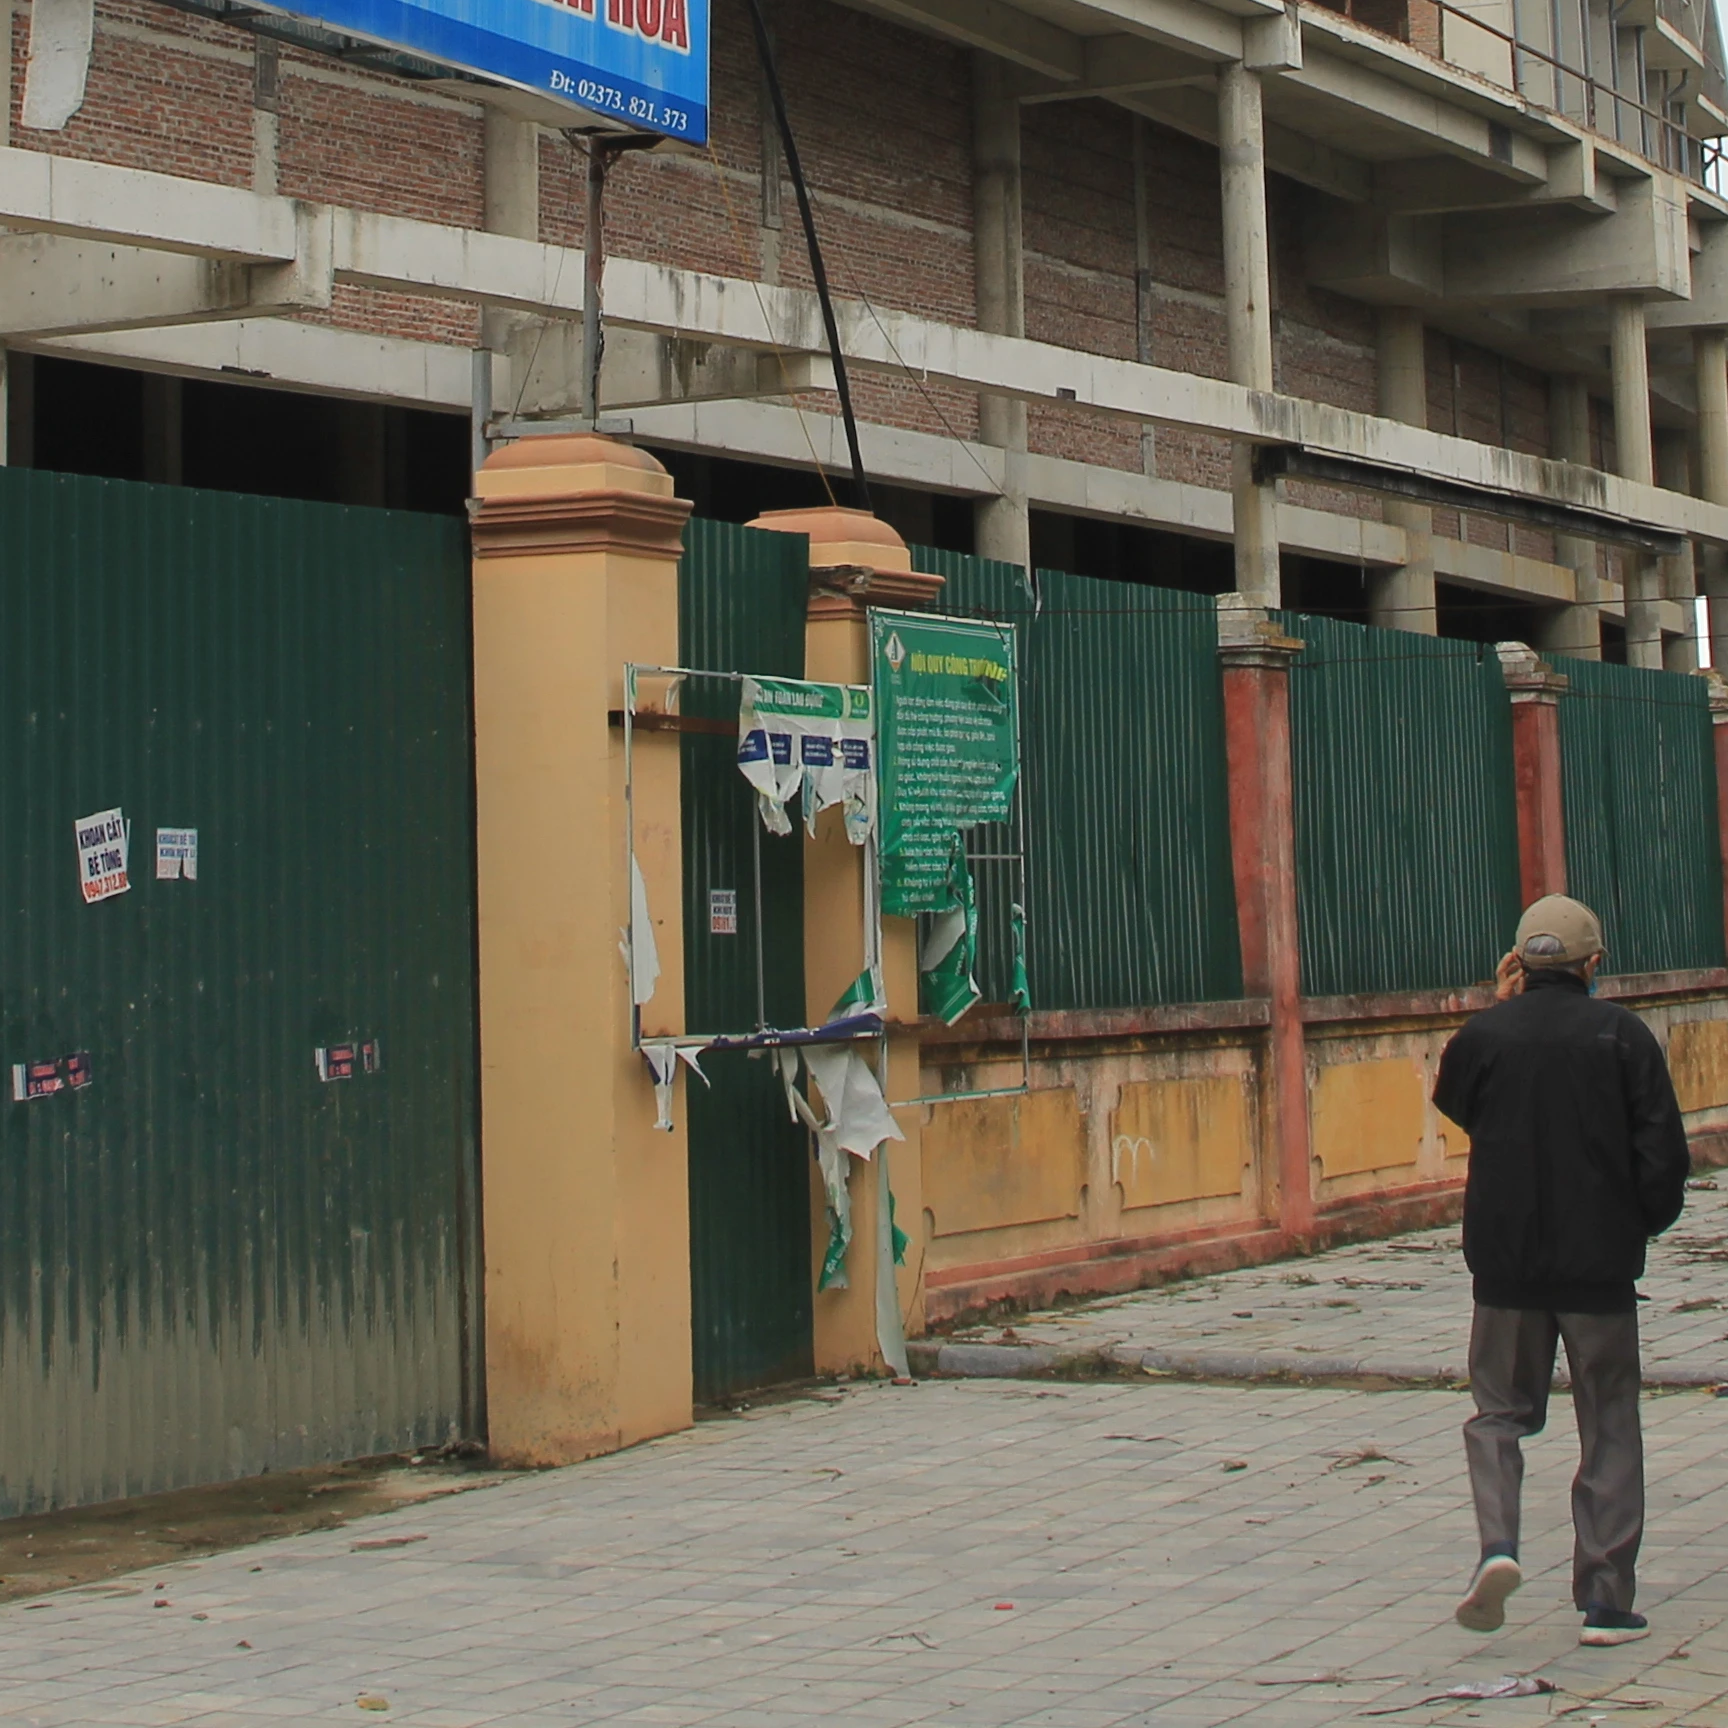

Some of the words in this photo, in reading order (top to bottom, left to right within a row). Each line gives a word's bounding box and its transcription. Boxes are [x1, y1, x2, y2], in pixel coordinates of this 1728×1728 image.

[549, 68, 575, 97] Đt:
[577, 78, 625, 112] 02373.
[628, 94, 659, 122] 821.
[662, 104, 688, 132] 373
[927, 655, 943, 674] QUY
